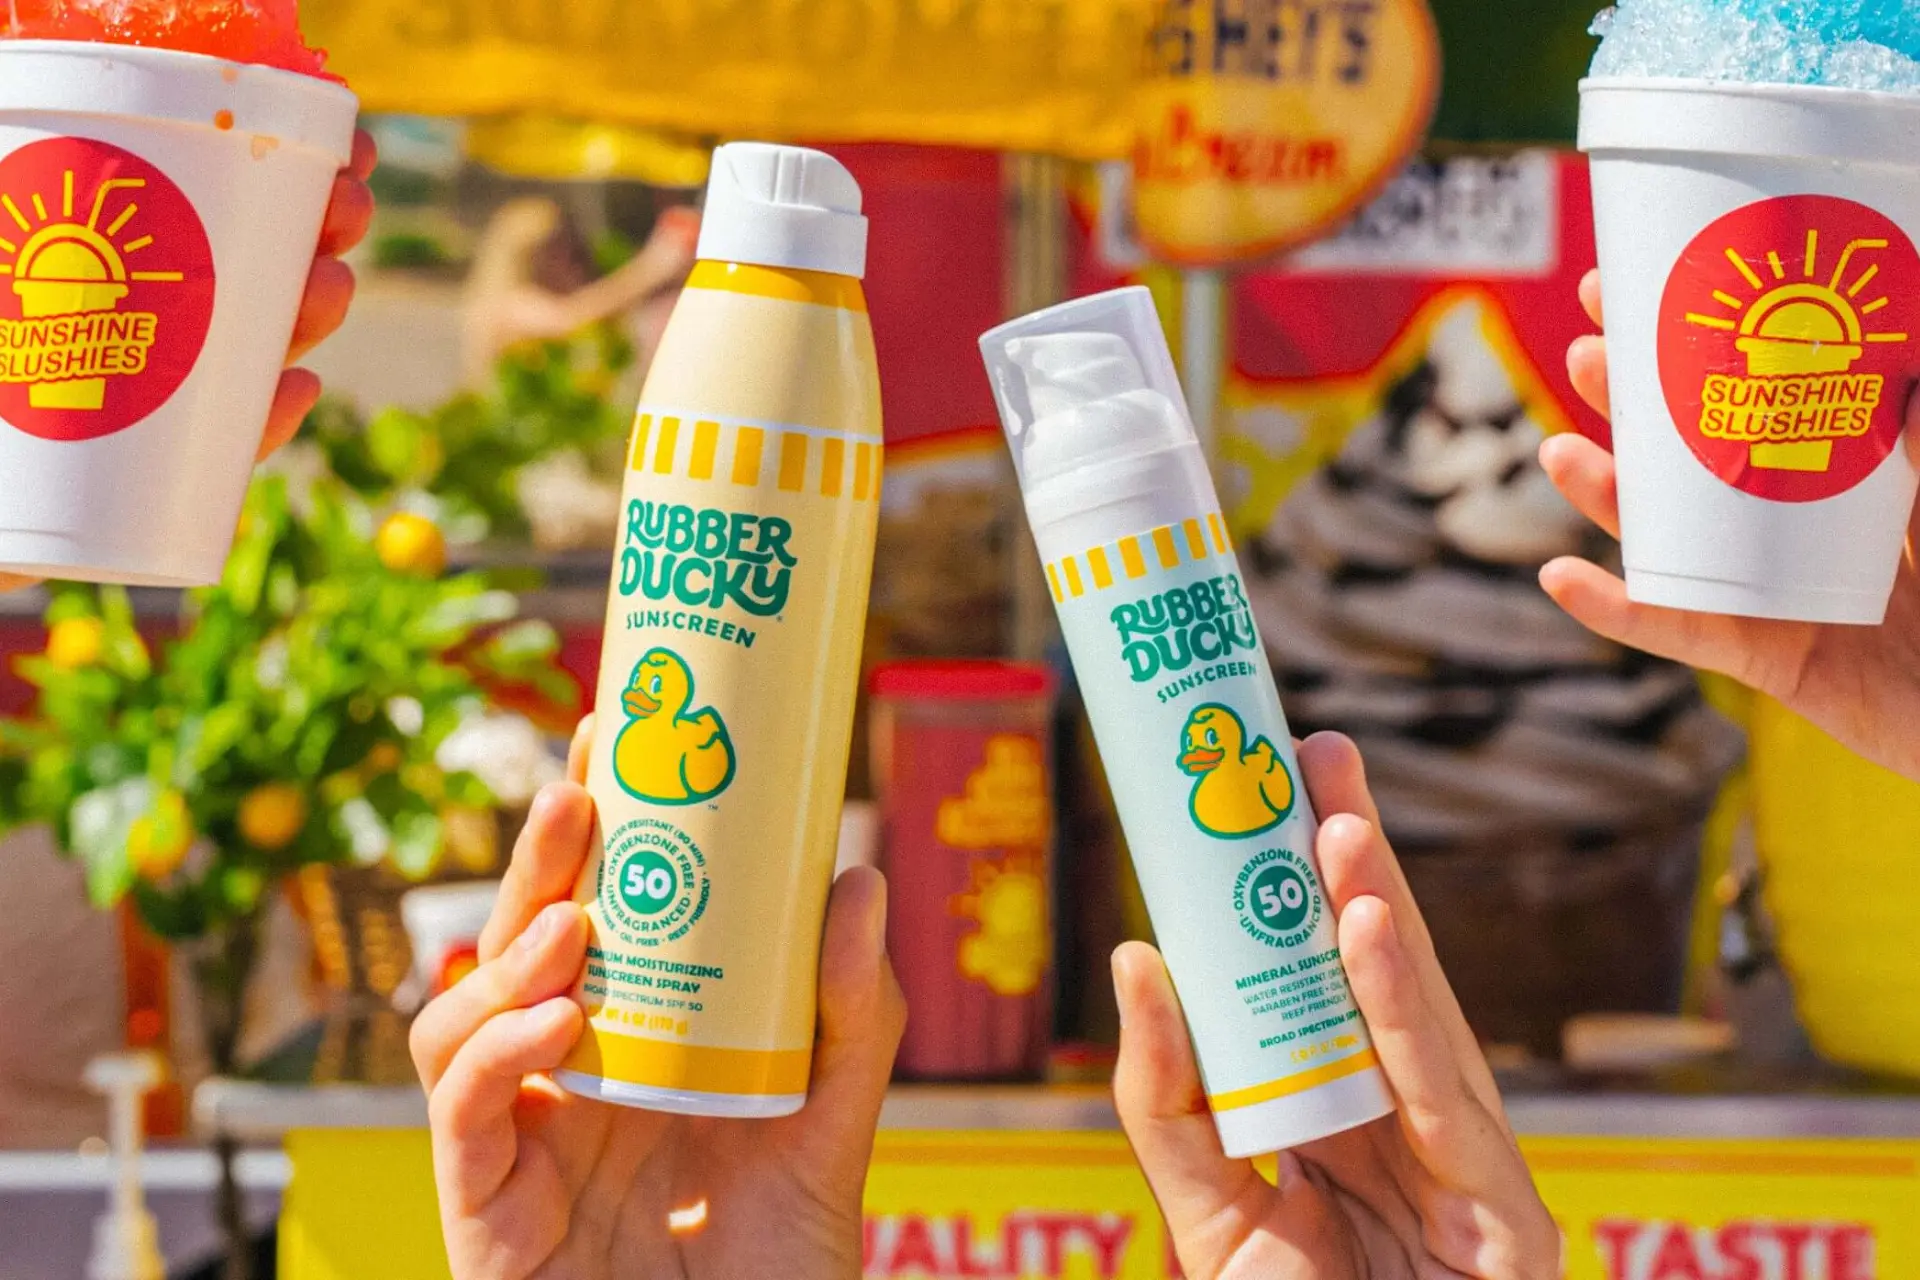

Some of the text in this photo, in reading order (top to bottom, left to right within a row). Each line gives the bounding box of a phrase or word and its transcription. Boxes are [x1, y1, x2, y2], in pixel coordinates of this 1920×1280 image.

[0, 317, 152, 349] SUNSHINE
[0, 345, 141, 377] SLUSHIES
[1706, 379, 1878, 408] SUNSHINE
[1704, 407, 1868, 435] SLUSHIES
[626, 498, 798, 567] RUBBER
[619, 547, 791, 617] DUCKY
[1110, 573, 1248, 645] RUBBER
[626, 610, 756, 649] SUNSCREEN
[1121, 610, 1257, 682] DUCKY
[1157, 661, 1257, 703] SUNSCREEN
[608, 833, 695, 889] OXYBENZONE FREE
[624, 864, 672, 900] 50
[1233, 848, 1318, 911] OXYBENZONE FREE
[606, 884, 691, 932] UNFRAGRANCED
[1257, 878, 1303, 918] 50
[1240, 895, 1321, 948] UNFRAGRANCED
[588, 964, 701, 993] SUNSCREEN SPRAY
[626, 954, 724, 979] MOISTURIZING
[1235, 964, 1297, 991] MINERAL
[612, 988, 664, 1007] SPECTRUM
[666, 999, 686, 1009] SPF
[687, 1002, 704, 1012] 50
[1244, 984, 1279, 1005] WATER
[1279, 971, 1326, 994] RESISTANT
[1252, 995, 1301, 1016] PARABEN
[1301, 986, 1325, 1000] FREE
[1281, 993, 1347, 1021] REEF FRIENDLY
[1260, 1030, 1297, 1049] BROAD
[1298, 1014, 1346, 1037] SPECTRUM
[1592, 1217, 1876, 1280] TASTE
